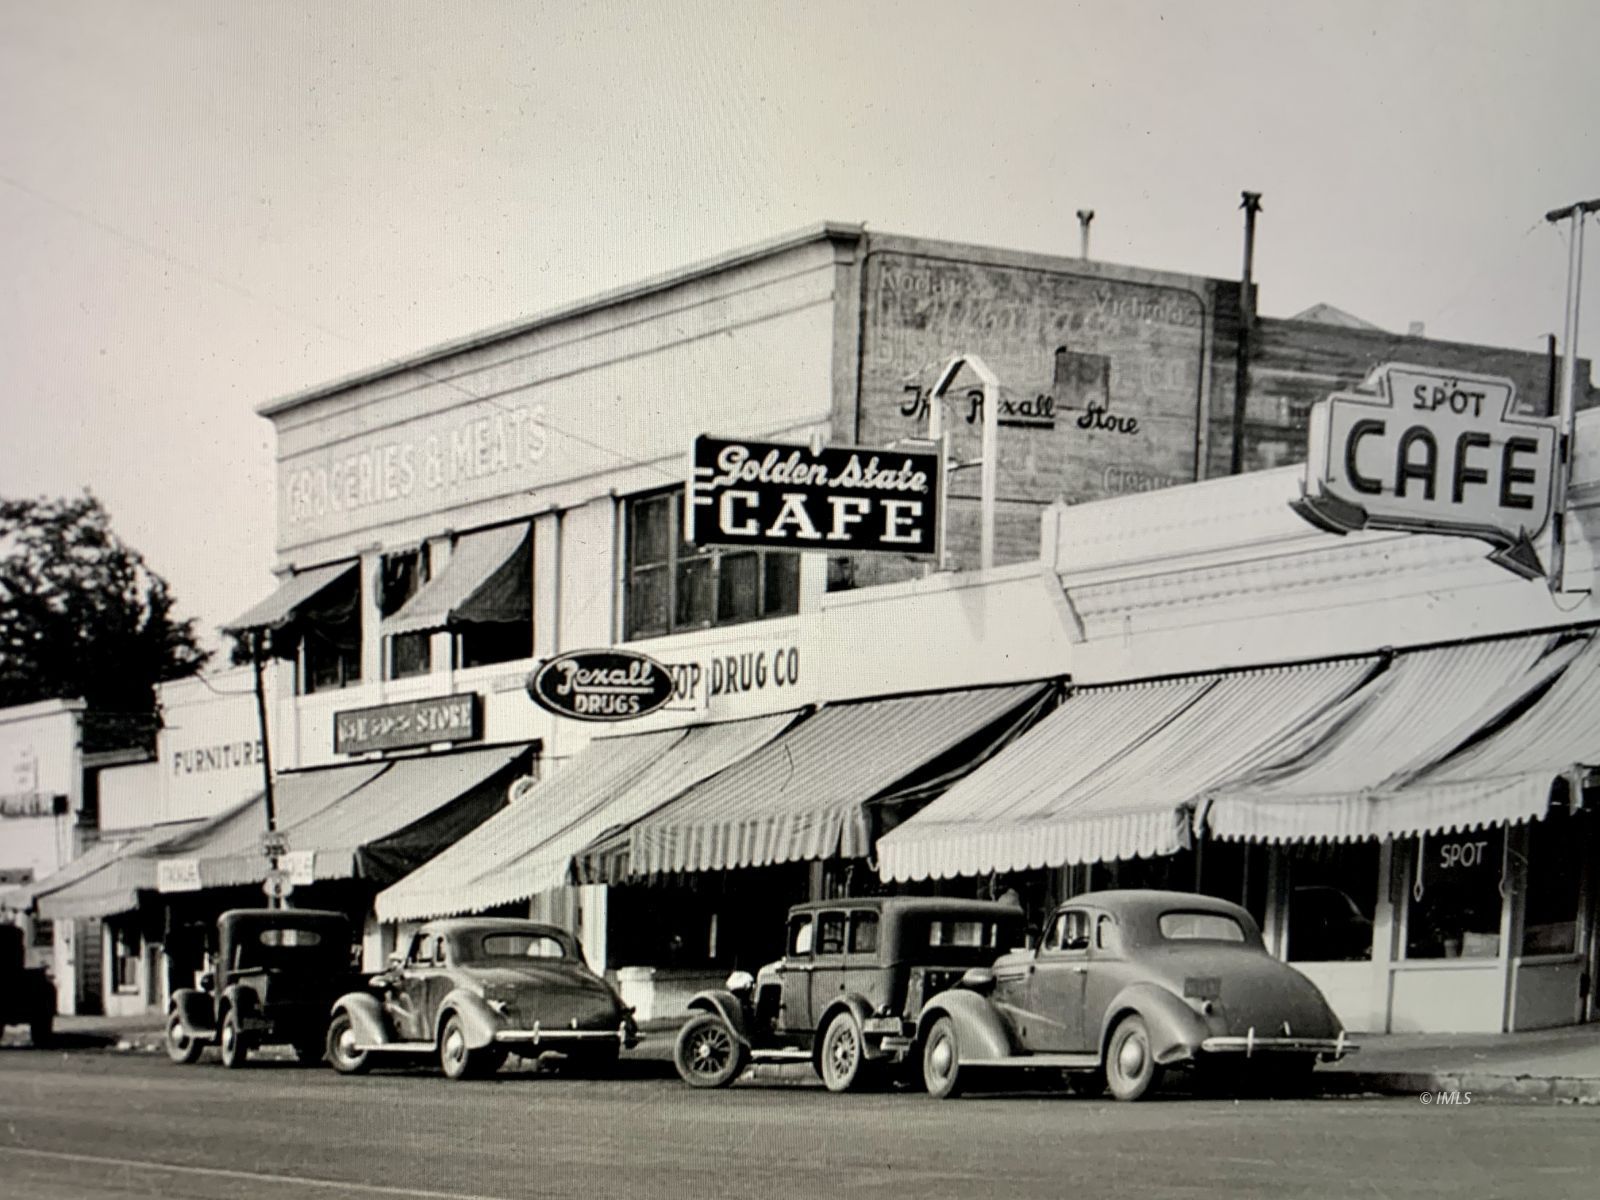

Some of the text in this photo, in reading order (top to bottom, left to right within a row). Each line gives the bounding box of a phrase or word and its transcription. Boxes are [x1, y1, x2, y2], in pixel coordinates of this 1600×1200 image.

[901, 385, 1140, 435] Th Rxall Store
[1413, 384, 1486, 417] SPOT
[286, 405, 548, 522] GROCERIES & MEATS
[714, 444, 929, 493] Golden State
[1345, 418, 1539, 510] CAFE
[719, 490, 923, 544] CAFE
[556, 659, 656, 696] Rexall
[711, 651, 767, 696] DRUG
[774, 647, 799, 687] CO
[574, 694, 641, 714] DRUGS
[174, 740, 264, 776] FURNITURE
[1440, 841, 1488, 869] SPOT
